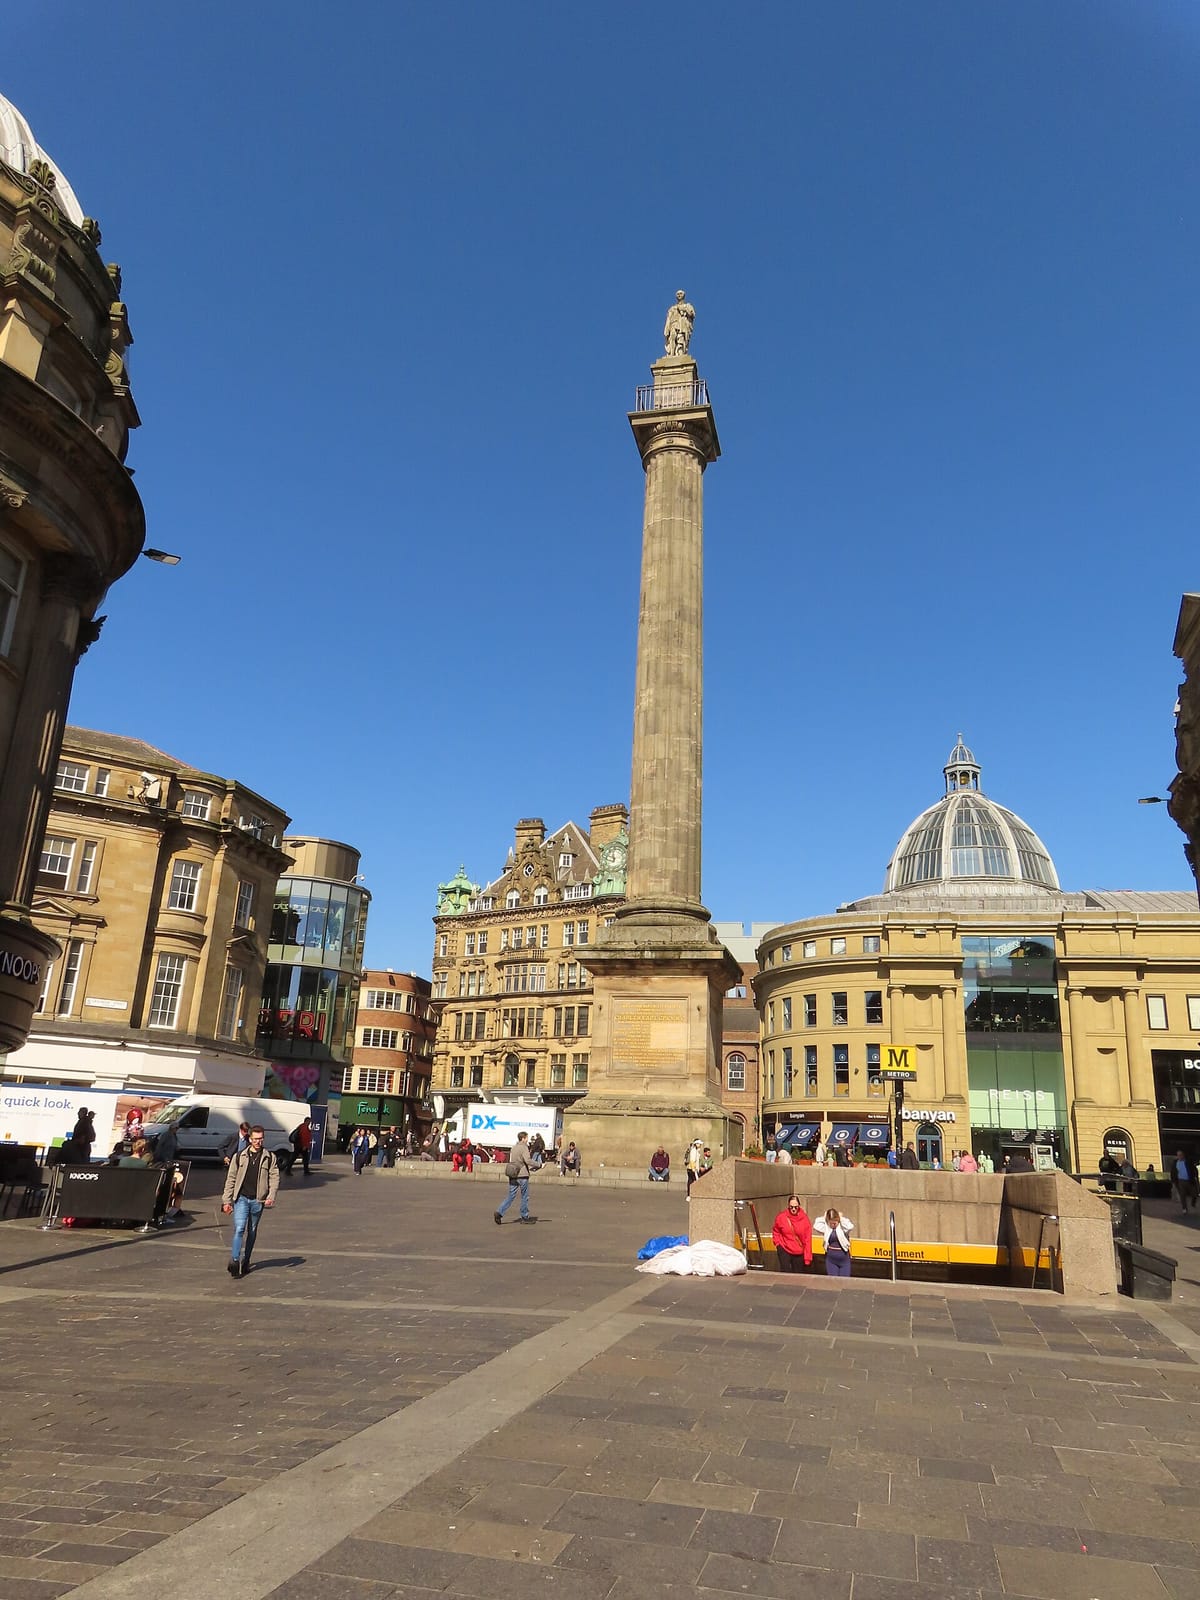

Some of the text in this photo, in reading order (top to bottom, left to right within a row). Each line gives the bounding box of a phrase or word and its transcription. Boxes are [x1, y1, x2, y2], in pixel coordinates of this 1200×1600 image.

[888, 1049, 909, 1067] M
[989, 1089, 1045, 1101] REISS
[4, 1096, 74, 1109] quick look.
[357, 1101, 390, 1115] Fenwk
[902, 1107, 955, 1122] banyan
[471, 1114, 497, 1130] DX
[69, 1172, 99, 1181] KNOOPS
